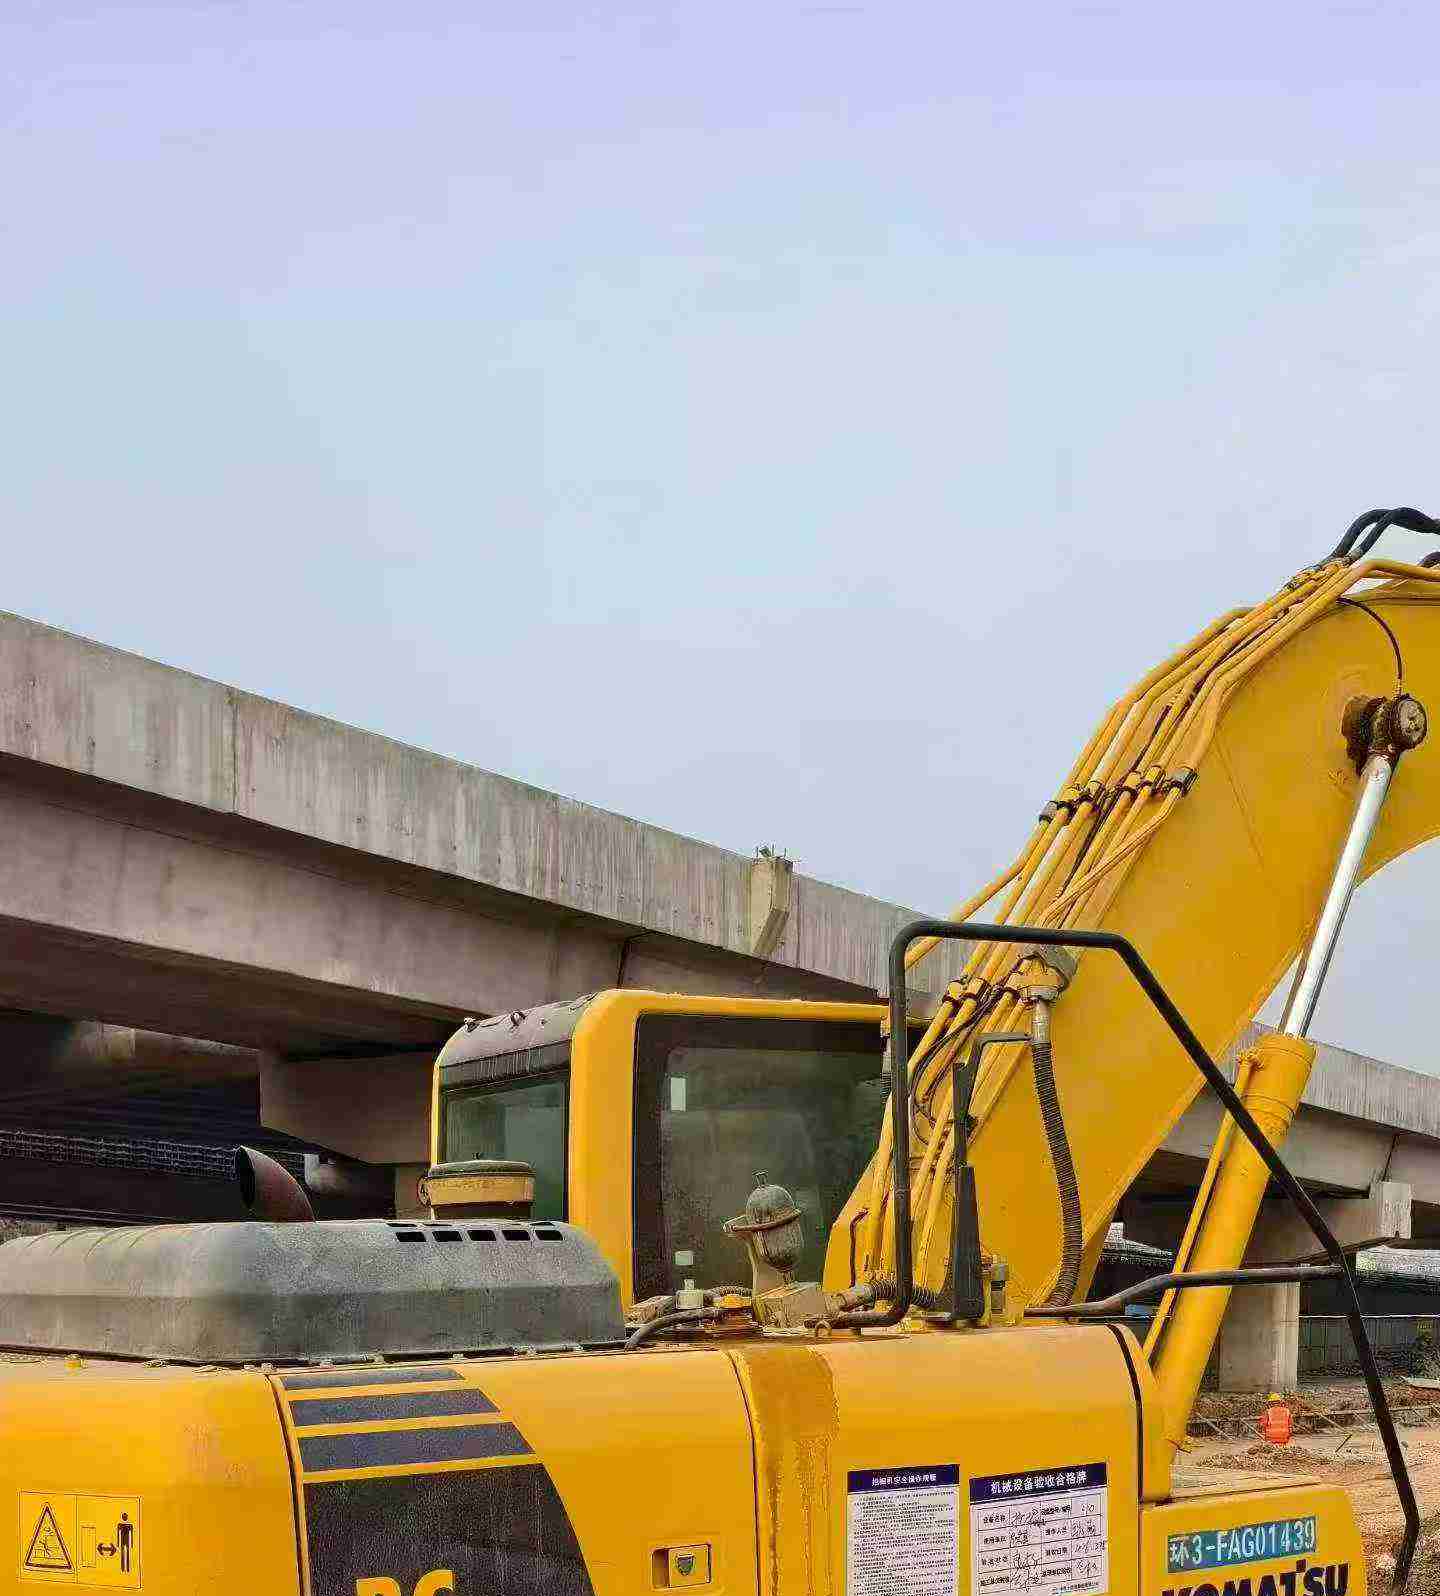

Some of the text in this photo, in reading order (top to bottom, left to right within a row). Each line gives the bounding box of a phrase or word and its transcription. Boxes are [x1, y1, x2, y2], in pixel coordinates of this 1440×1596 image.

[990, 1470, 1087, 1494] 机械设备验收合格牌
[1169, 1518, 1315, 1567] 环3-FAG01439
